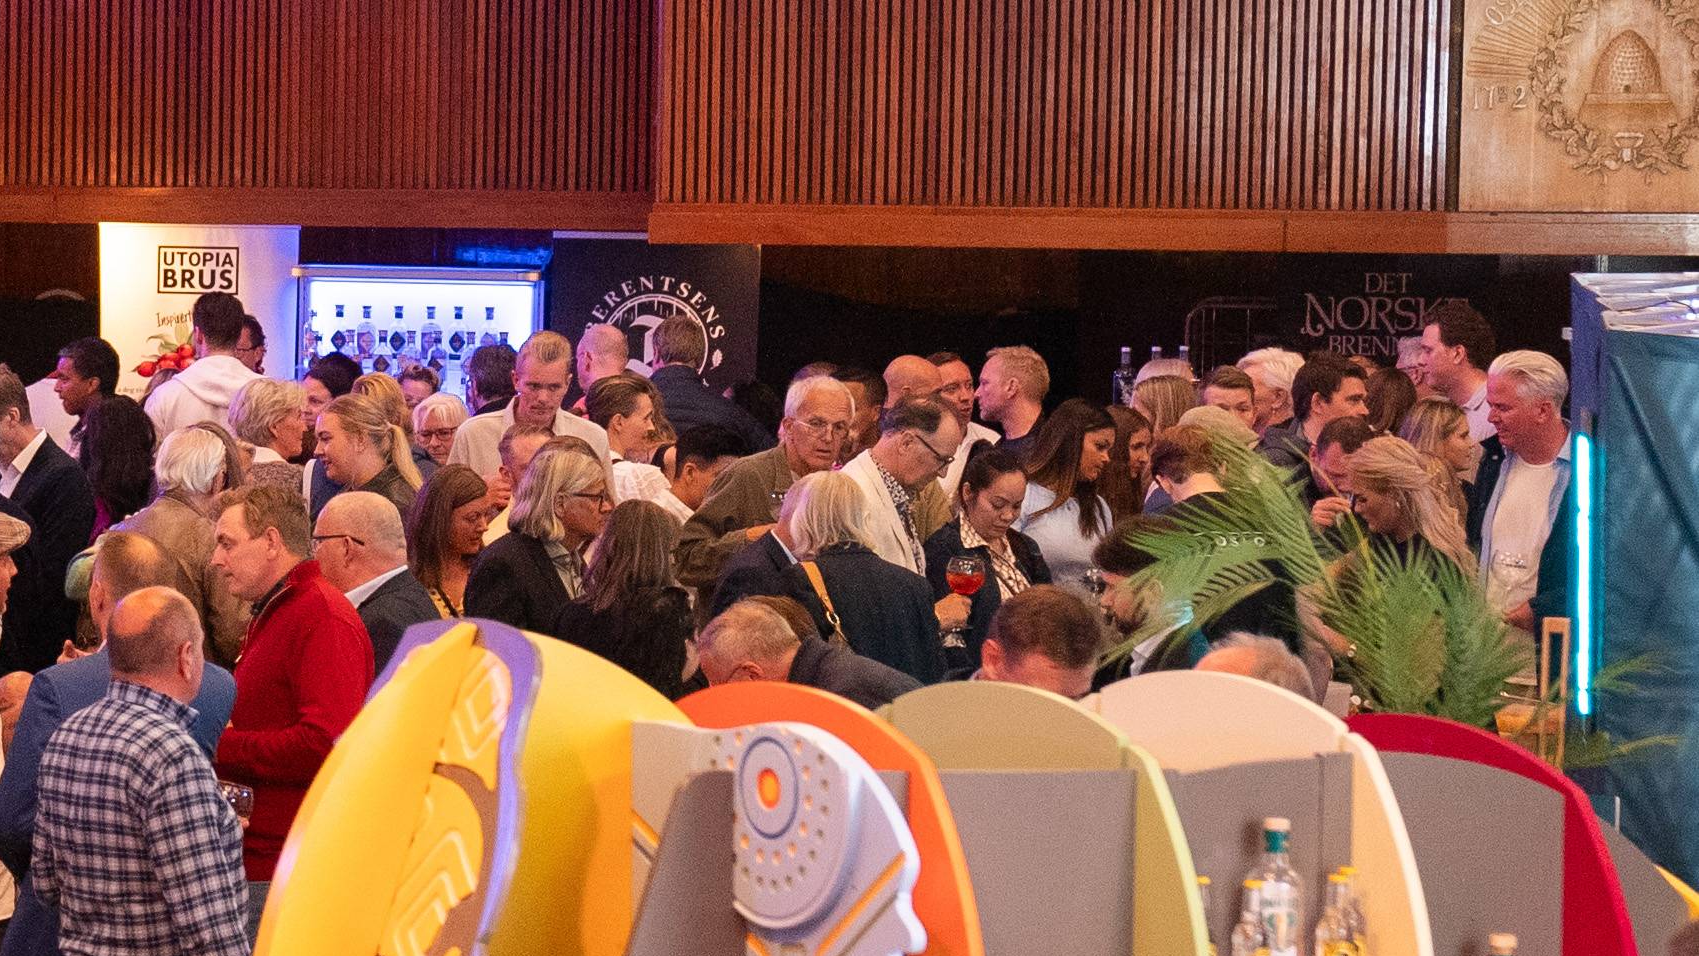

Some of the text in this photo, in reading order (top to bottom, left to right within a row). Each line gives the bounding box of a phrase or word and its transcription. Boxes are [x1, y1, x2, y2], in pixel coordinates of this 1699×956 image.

[163, 251, 234, 268] UTOPIA
[162, 268, 233, 290] BRUS
[1364, 272, 1413, 294] DET
[1301, 292, 1469, 338] NORSK
